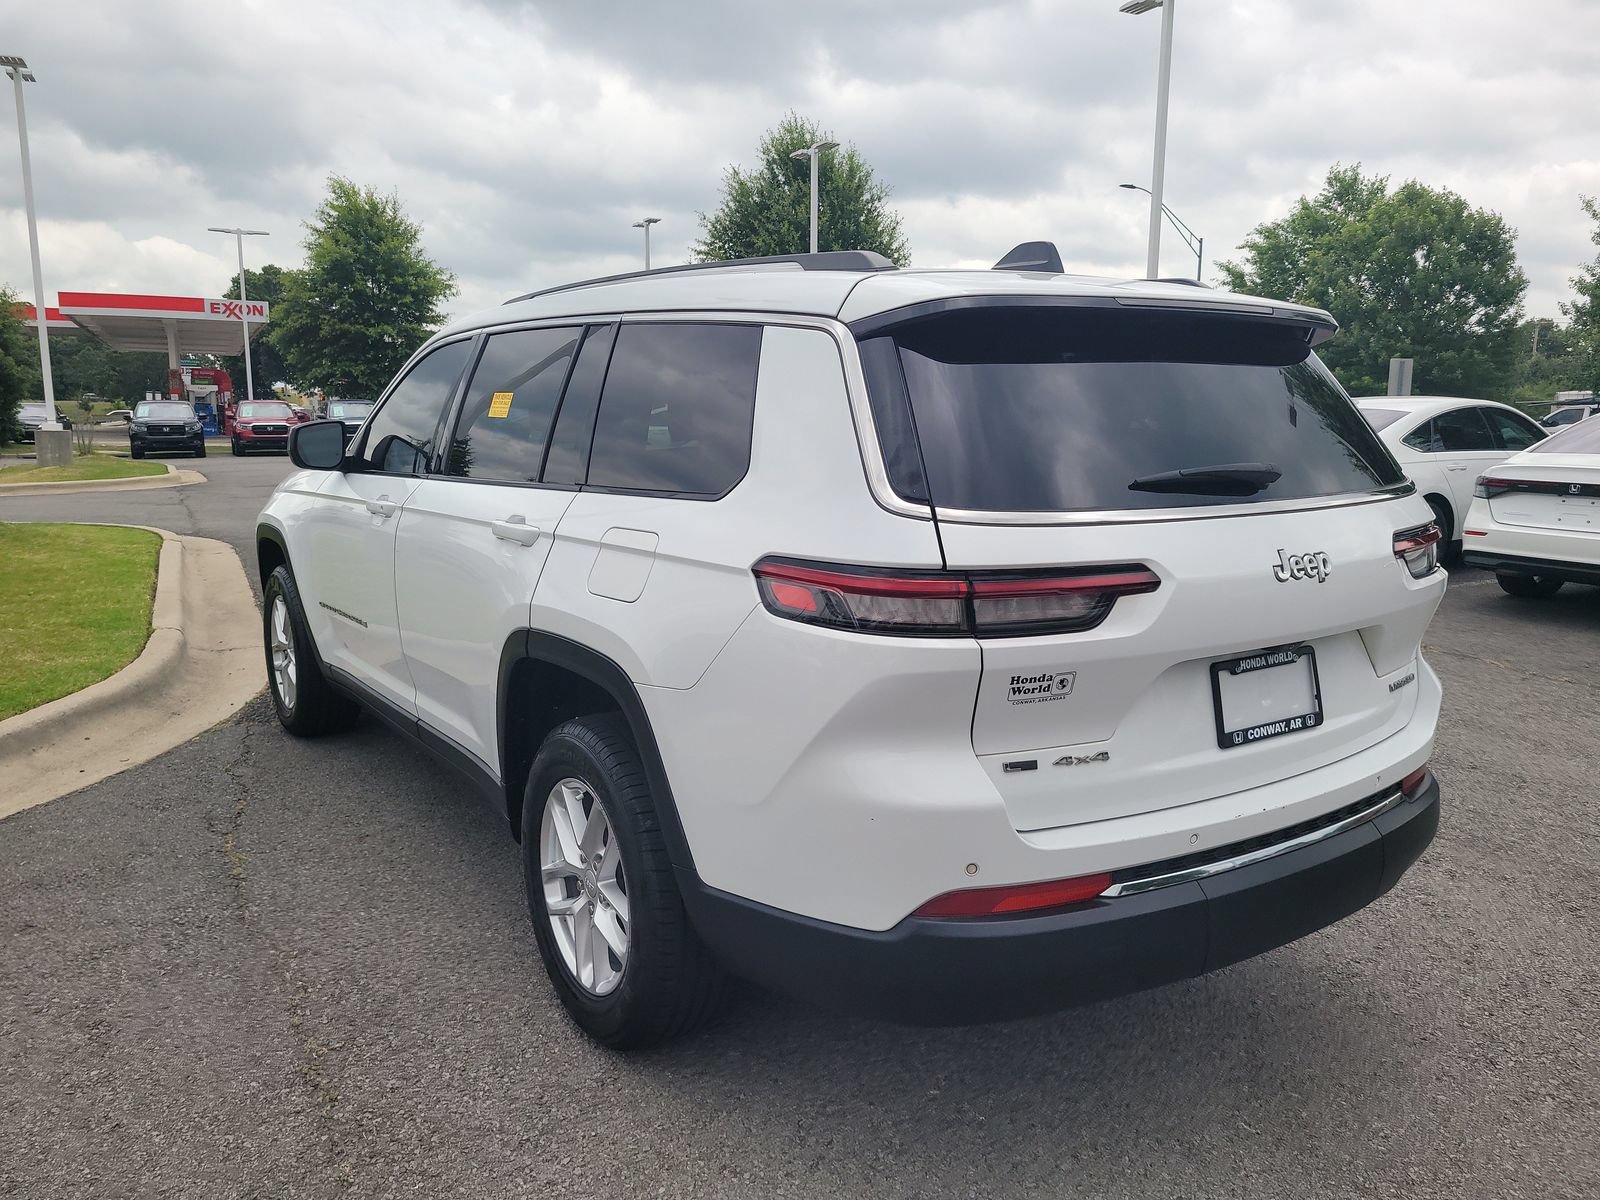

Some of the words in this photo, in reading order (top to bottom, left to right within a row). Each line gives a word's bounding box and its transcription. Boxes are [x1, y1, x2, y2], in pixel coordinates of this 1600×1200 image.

[210, 302, 264, 320] EXXON
[1273, 549, 1331, 583] Jeep
[1240, 657, 1266, 670] HONDA
[1267, 651, 1293, 664] WORLD
[1010, 674, 1053, 685] Honda
[1012, 684, 1051, 695] World
[1248, 723, 1288, 740] CONWAY,
[1290, 718, 1302, 730] AR
